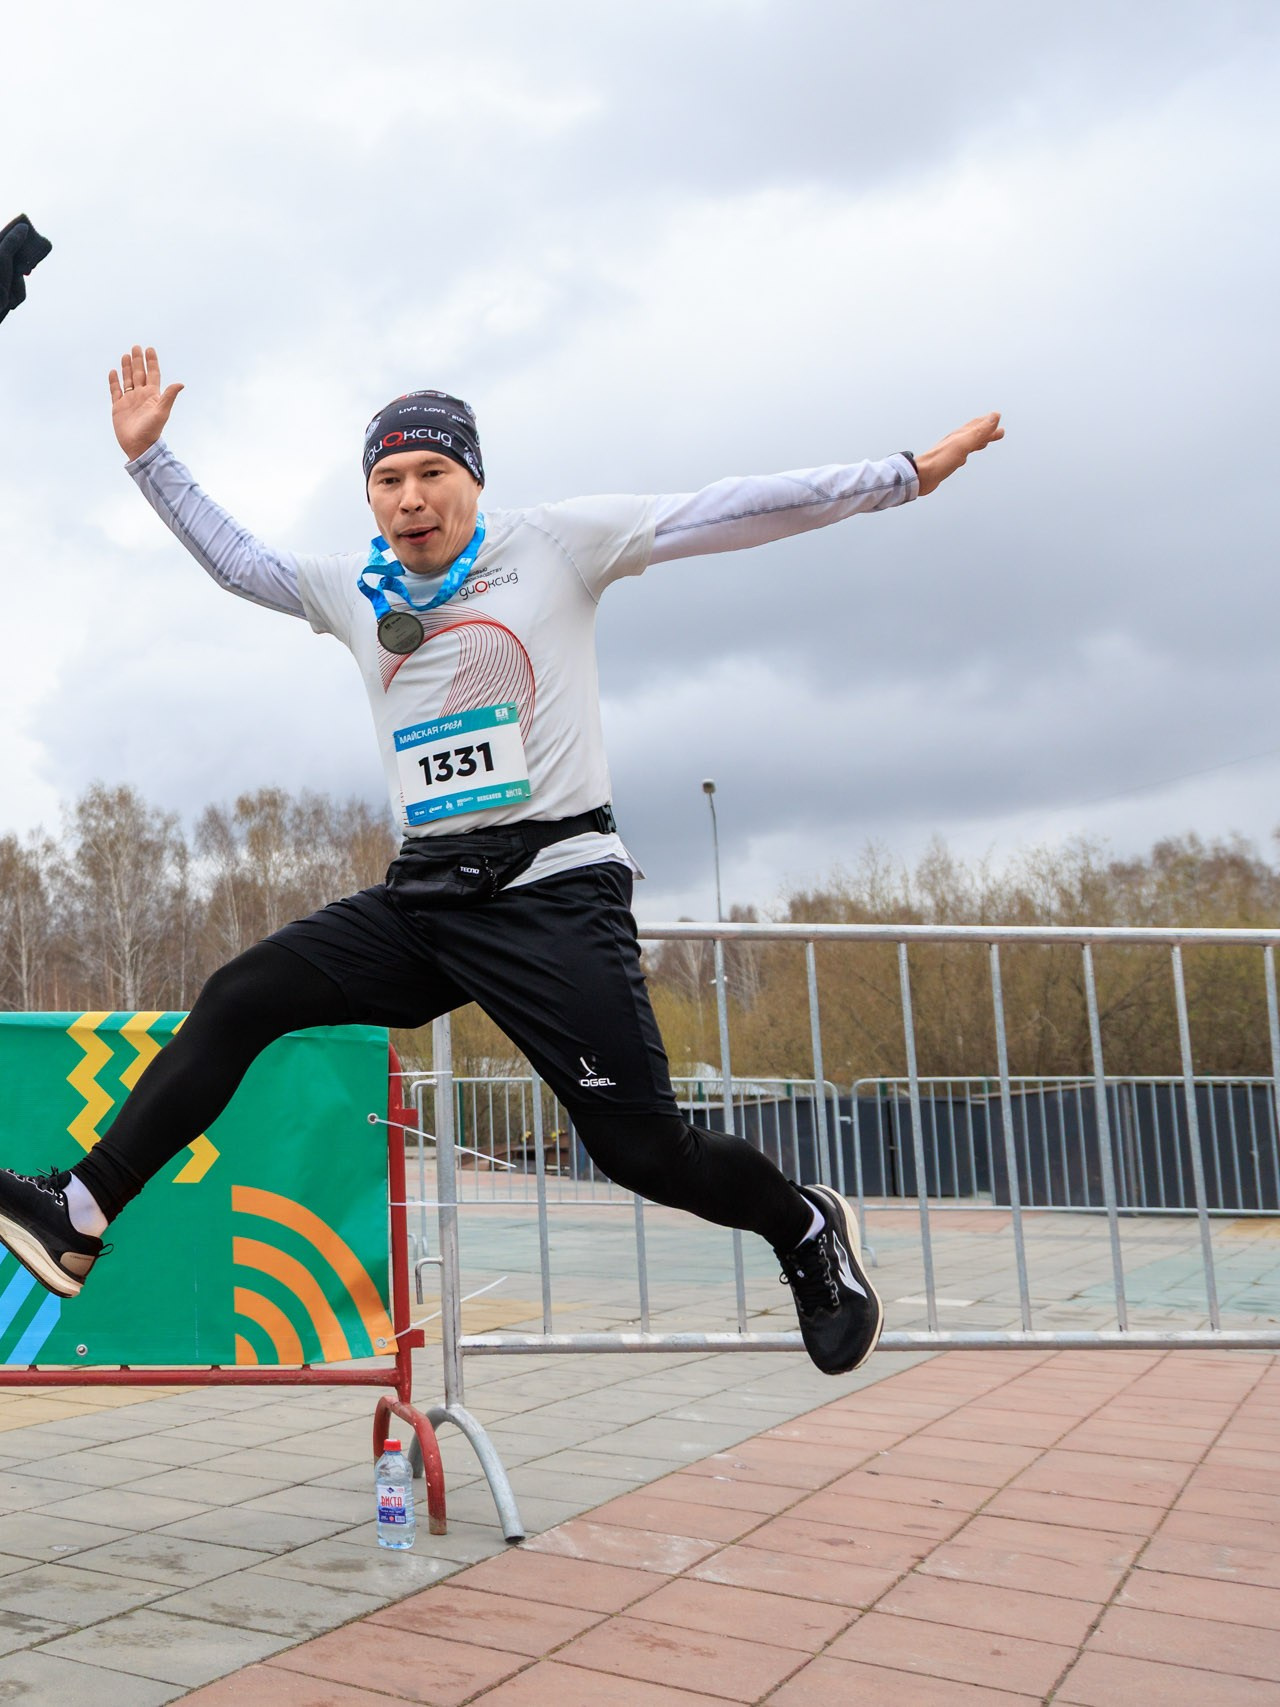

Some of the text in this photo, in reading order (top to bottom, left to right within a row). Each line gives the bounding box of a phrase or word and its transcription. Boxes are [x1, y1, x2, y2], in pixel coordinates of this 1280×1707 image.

[399, 406, 418, 414] LIVE
[399, 720, 463, 744] МАЙСКАЯ ГРОЗА
[418, 741, 495, 786] 1331
